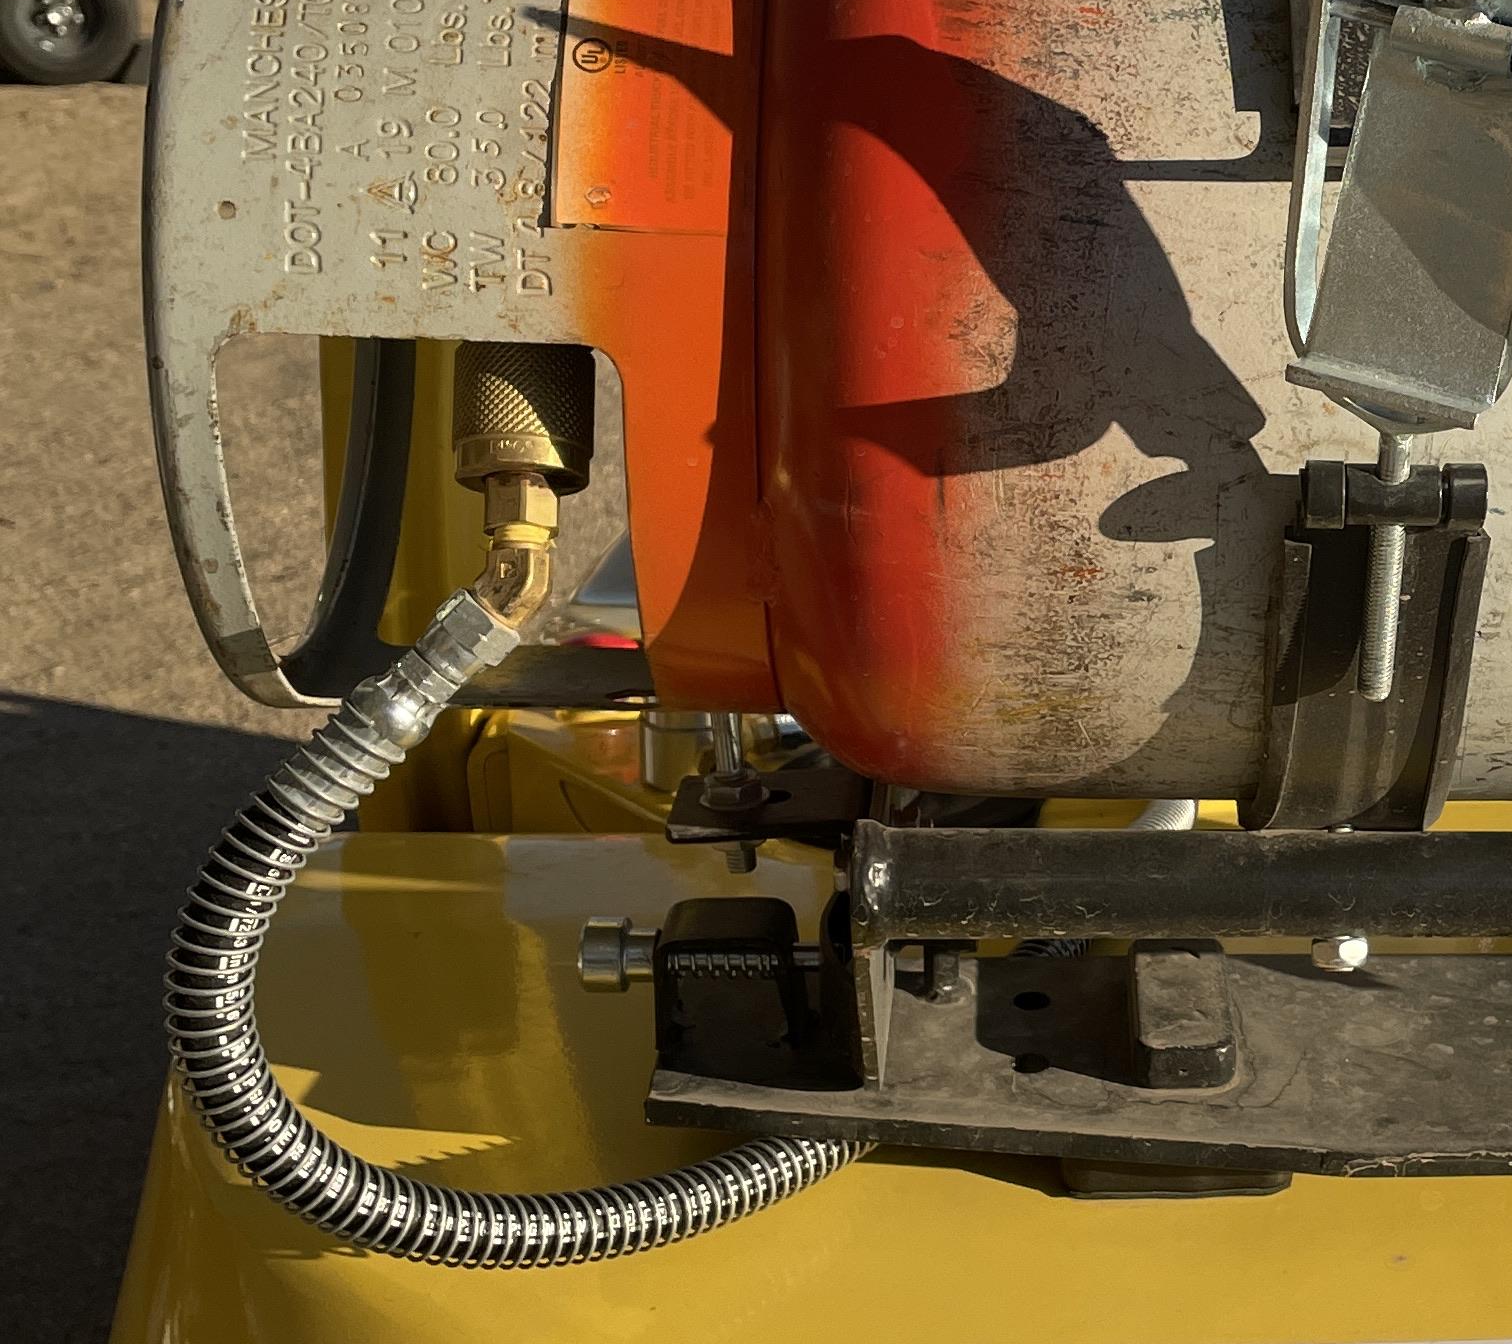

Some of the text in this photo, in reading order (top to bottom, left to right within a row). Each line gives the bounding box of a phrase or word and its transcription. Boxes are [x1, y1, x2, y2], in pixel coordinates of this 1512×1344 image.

[428, 4, 468, 66] Lbs.
[381, 66, 418, 98] M
[335, 138, 371, 161] A
[376, 118, 414, 159] 19
[423, 105, 462, 185] 80.0
[369, 228, 408, 269] 11
[421, 230, 458, 291] WC
[468, 230, 505, 295] TW
[515, 246, 552, 296] DT
